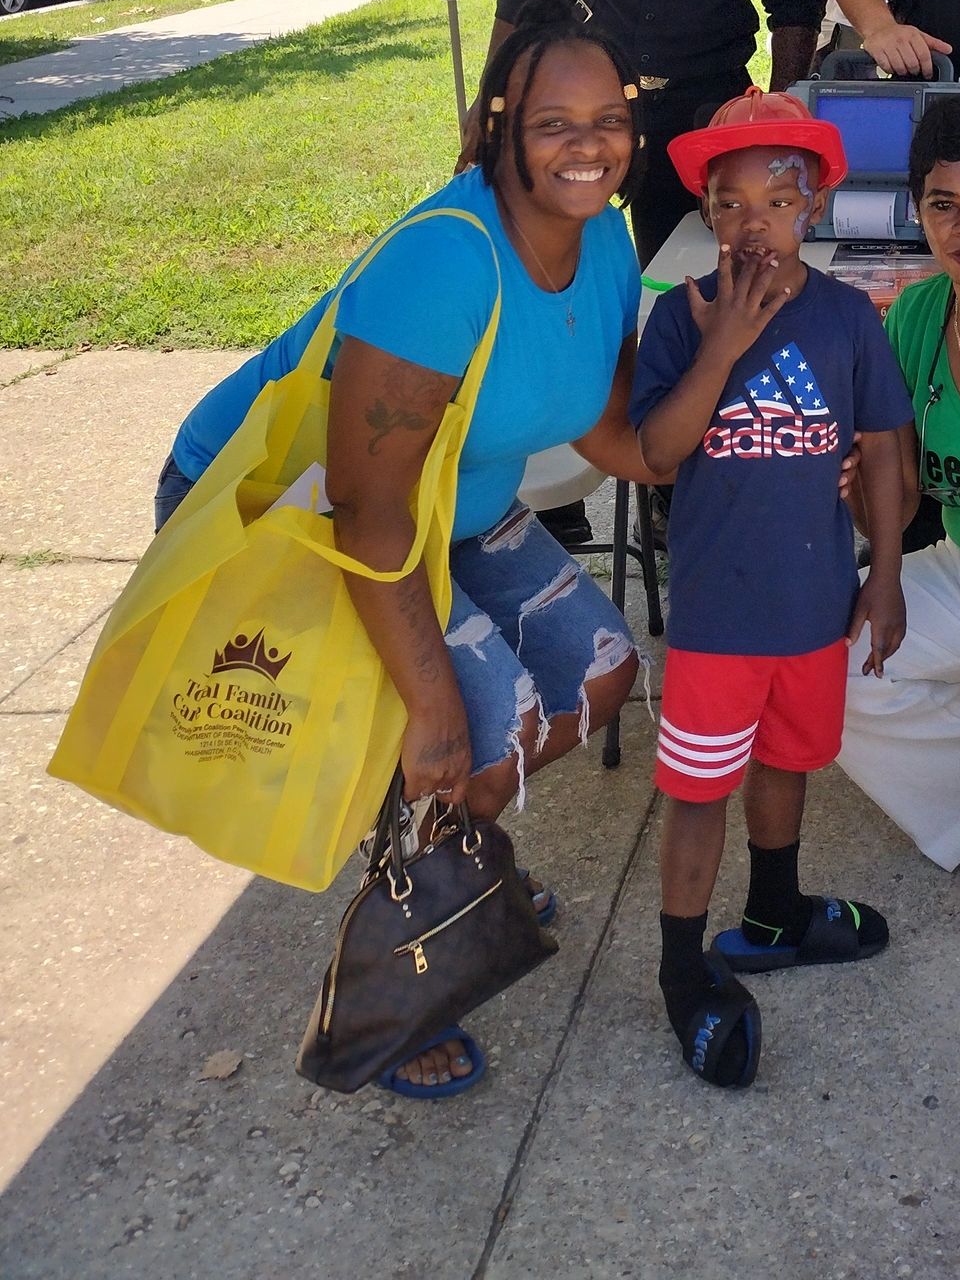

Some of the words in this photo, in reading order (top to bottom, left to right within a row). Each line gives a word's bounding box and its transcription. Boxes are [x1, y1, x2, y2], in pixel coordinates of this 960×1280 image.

[703, 415, 839, 459] adidas
[226, 684, 293, 716] Family
[206, 702, 293, 736] Coalition
